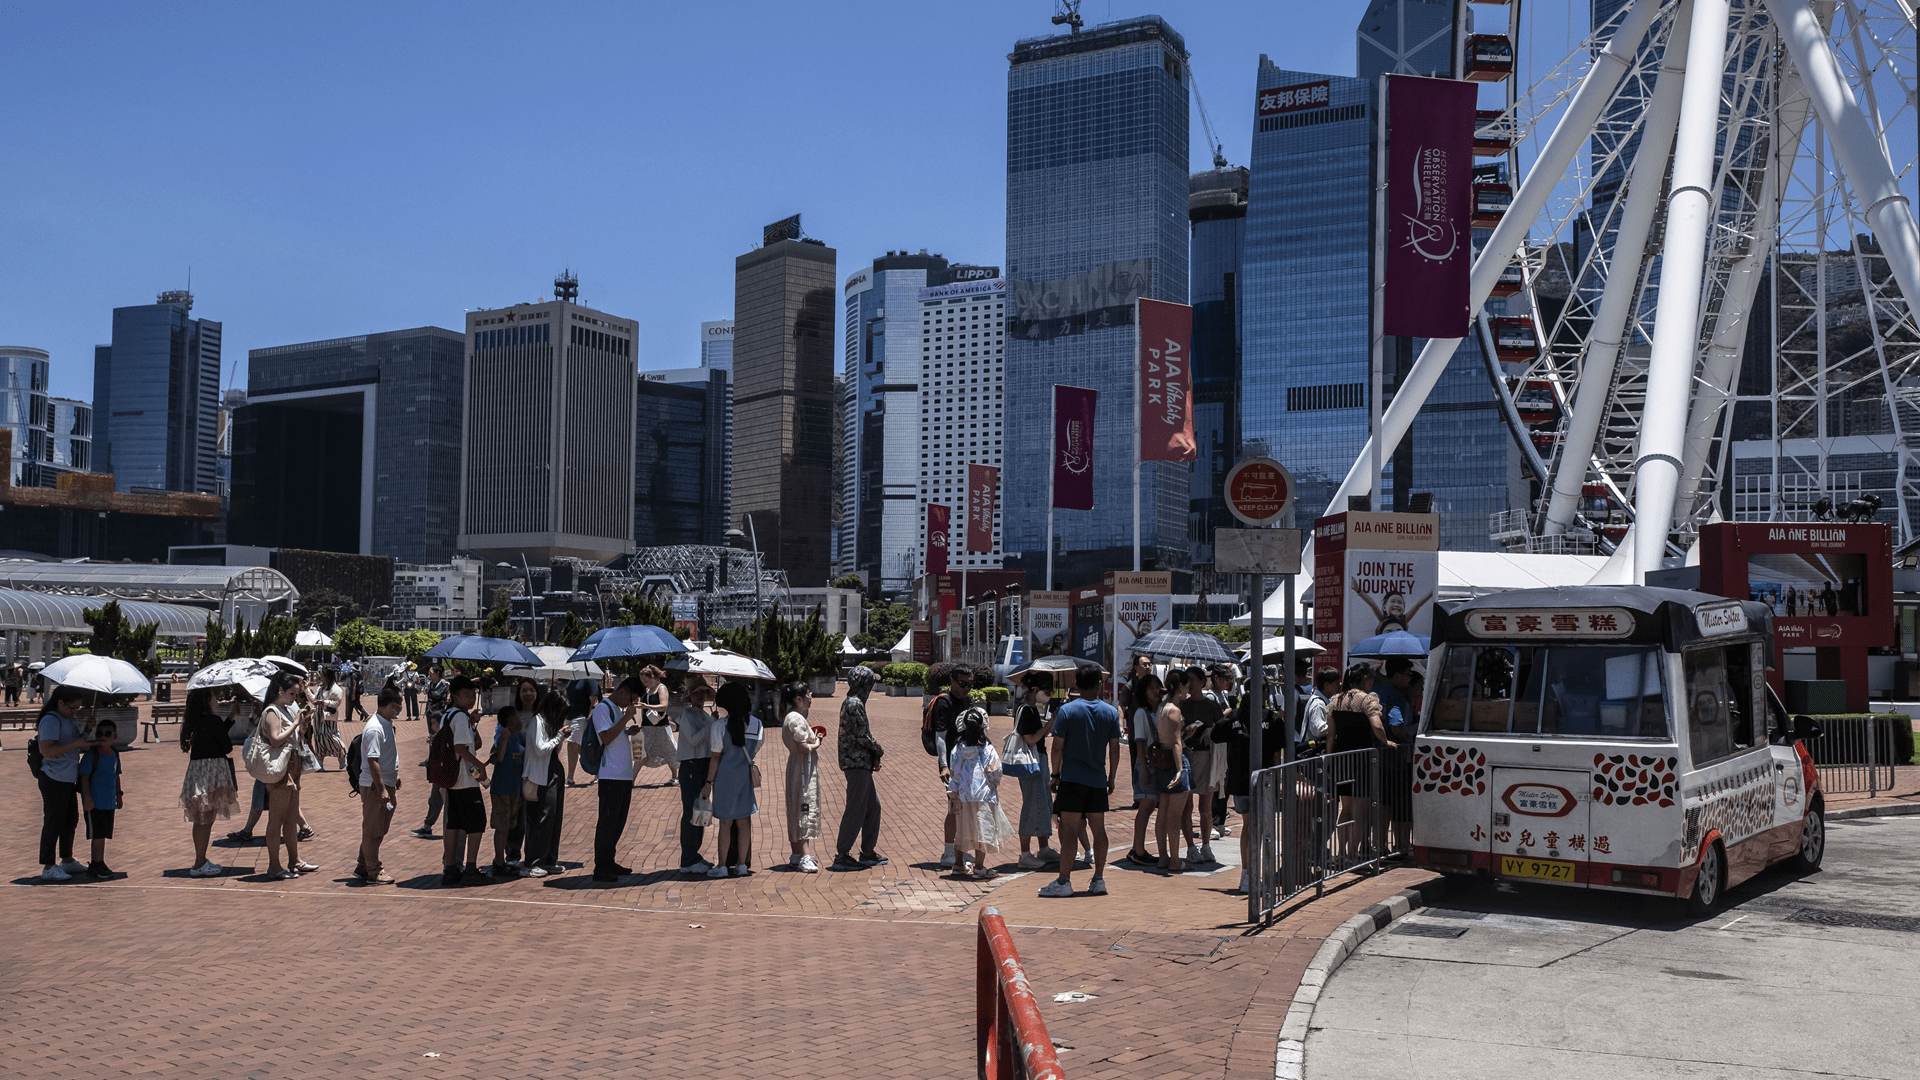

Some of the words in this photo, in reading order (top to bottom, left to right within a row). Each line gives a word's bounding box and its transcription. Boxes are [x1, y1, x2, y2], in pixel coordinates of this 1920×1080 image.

[1260, 85, 1328, 110] 友邦保險
[1423, 149, 1431, 180] WHEEL
[1432, 148, 1440, 221] OBSERVATION
[956, 269, 994, 279] LIPPO
[930, 289, 949, 298] BANK
[950, 288, 958, 296] OF
[960, 286, 992, 294] AMERICA
[1164, 338, 1181, 378] AIA
[1148, 348, 1161, 404] PARK
[1161, 382, 1184, 425] Vitality
[982, 484, 990, 506] AIA
[1354, 522, 1372, 533] AIA
[1768, 528, 1786, 540] AIA
[1357, 562, 1385, 576] JOIN
[1389, 562, 1414, 578] THE
[1356, 579, 1415, 594] JOURNEY
[1121, 602, 1139, 611] JOIN
[1141, 602, 1157, 611] THE
[1050, 613, 1061, 621] THE
[1121, 612, 1158, 622] JOURNEY
[1480, 614, 1618, 632] 富豪雪糕
[1702, 612, 1723, 628] Mister
[1724, 609, 1741, 626] Softee
[1518, 790, 1539, 799] Mister
[1540, 792, 1558, 800] Softee
[1520, 800, 1557, 810] 富豪雪糕
[1470, 824, 1612, 854] 小心兒童橫過
[1505, 860, 1524, 873] VY
[1531, 863, 1571, 879] 9727
